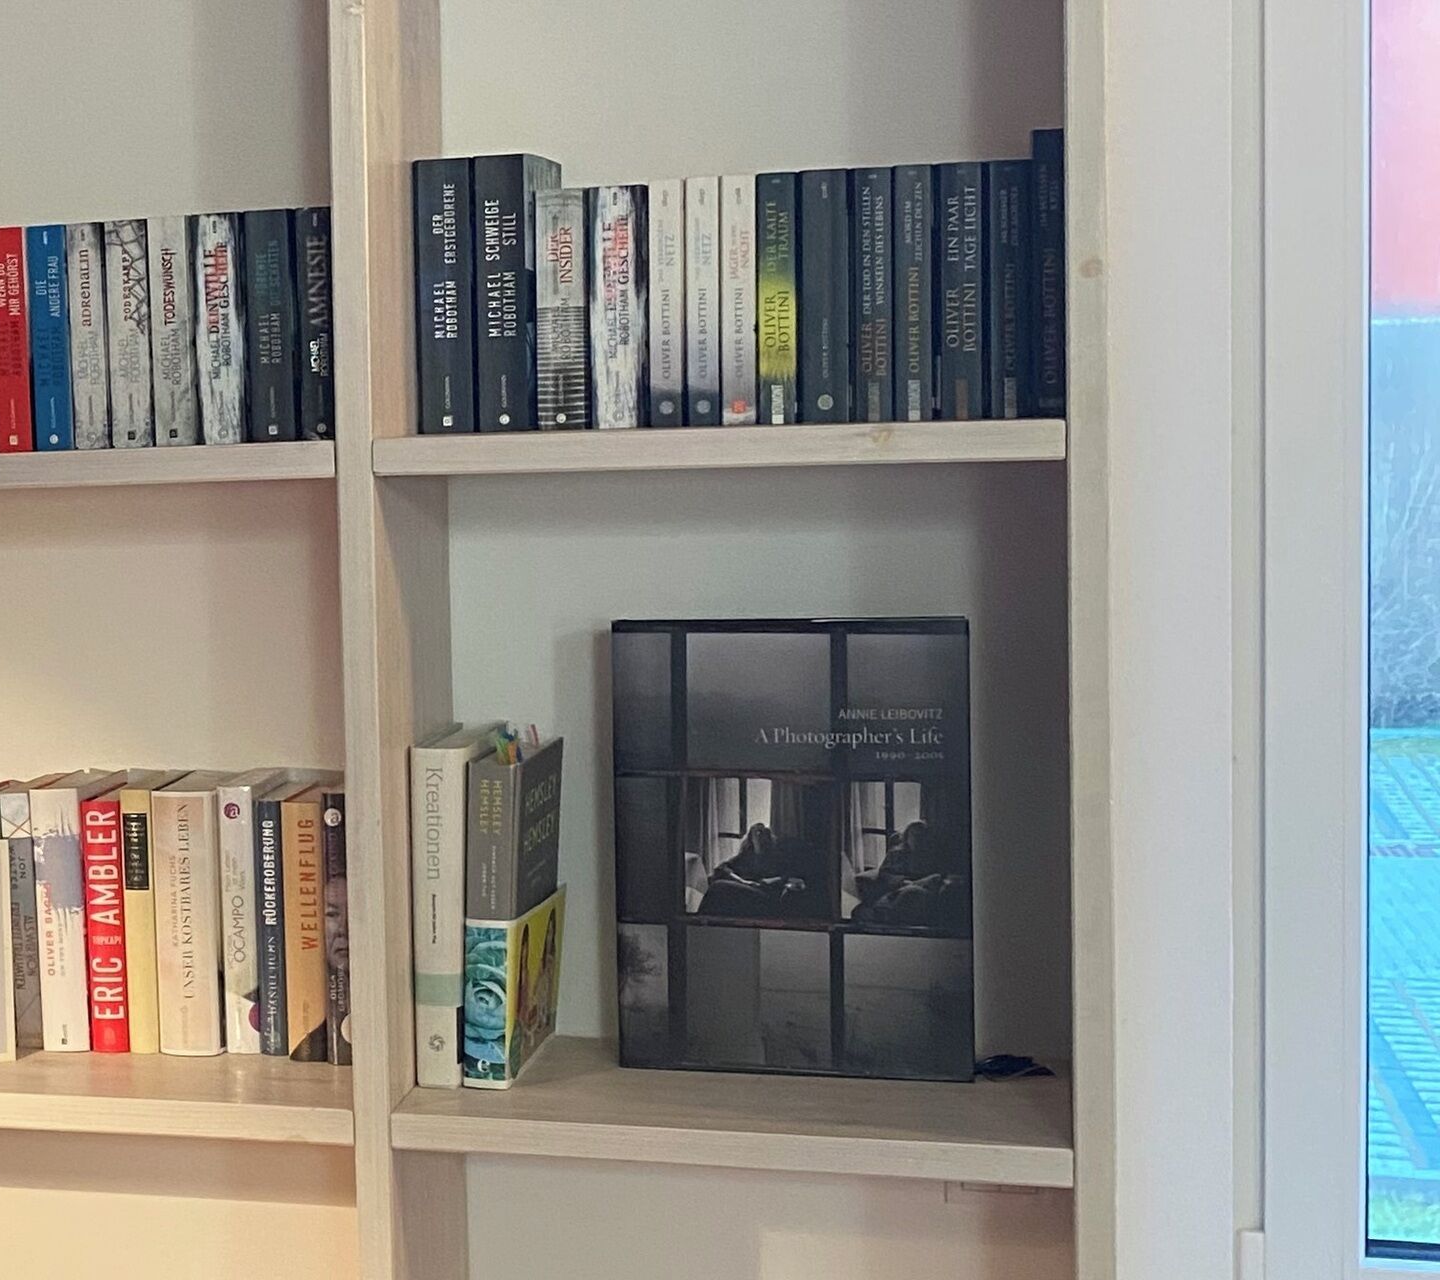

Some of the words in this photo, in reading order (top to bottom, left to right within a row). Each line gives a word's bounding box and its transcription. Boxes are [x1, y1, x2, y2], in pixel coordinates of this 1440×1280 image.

[432, 214, 444, 234] DER
[444, 183, 456, 264] ERSTGEBORENE
[484, 200, 499, 261] SCHWEIGE
[502, 212, 516, 245] STILL
[765, 201, 777, 240] KALTE
[947, 196, 959, 231] PAAR
[963, 186, 976, 229] LICHT
[546, 234, 559, 262] DER
[559, 226, 573, 283] INSIDER
[665, 234, 675, 266] NETZ
[766, 245, 777, 272] DER
[778, 211, 789, 258] TRAUM
[948, 237, 960, 261] EIN
[964, 236, 977, 271] TAGE
[6, 253, 19, 295] GEHÖRST
[36, 279, 47, 295] DIE
[48, 255, 59, 279] FRAU
[161, 249, 177, 326] TODESWUNSCH
[306, 236, 327, 328] AMNESIE
[8, 298, 20, 315] MIR
[49, 282, 61, 317] ANDERE
[208, 303, 220, 333] DEIN
[433, 281, 445, 338] MICHAEL
[446, 280, 458, 338] ROBOTHAM
[487, 272, 501, 336] MICHAEL
[503, 272, 516, 336] ROBOTHAM
[660, 289, 671, 335] BOTTINI
[696, 288, 707, 334] BOTTINI
[908, 266, 920, 321] BOTTINI
[946, 288, 960, 347] OLIVER
[963, 283, 977, 352] BOTTINI
[220, 313, 231, 366] ROBOTHAM
[764, 295, 777, 348] OLIVER
[777, 290, 790, 351] BOTTINI
[161, 336, 171, 380] MICHAEL
[170, 329, 182, 385] ROBOTHAM
[661, 338, 671, 379] OLIVER
[697, 337, 708, 378] OLIVER
[861, 322, 873, 372] OLIVER
[874, 318, 888, 376] BOTTINI
[908, 325, 920, 373] OLIVER
[754, 728, 769, 744] A
[773, 727, 905, 749] Photographer's
[909, 725, 944, 745] Life
[839, 709, 877, 720] ANNIE
[881, 709, 943, 720] LEIBOVITZ
[177, 803, 190, 851] LEBEN
[426, 767, 443, 880] Kreationen
[480, 779, 489, 834] HEMSLEY
[18, 857, 27, 879] JON
[85, 809, 121, 926] AMBLER
[261, 819, 277, 926] RÜCKEROBERUNG
[296, 818, 318, 950] WELLENFLUG
[170, 891, 179, 947] KATHARINA
[179, 855, 193, 945] KOSTBARES
[232, 895, 246, 963] OCAMPO
[91, 957, 125, 1020] ERIC
[182, 950, 195, 999] UNSER
